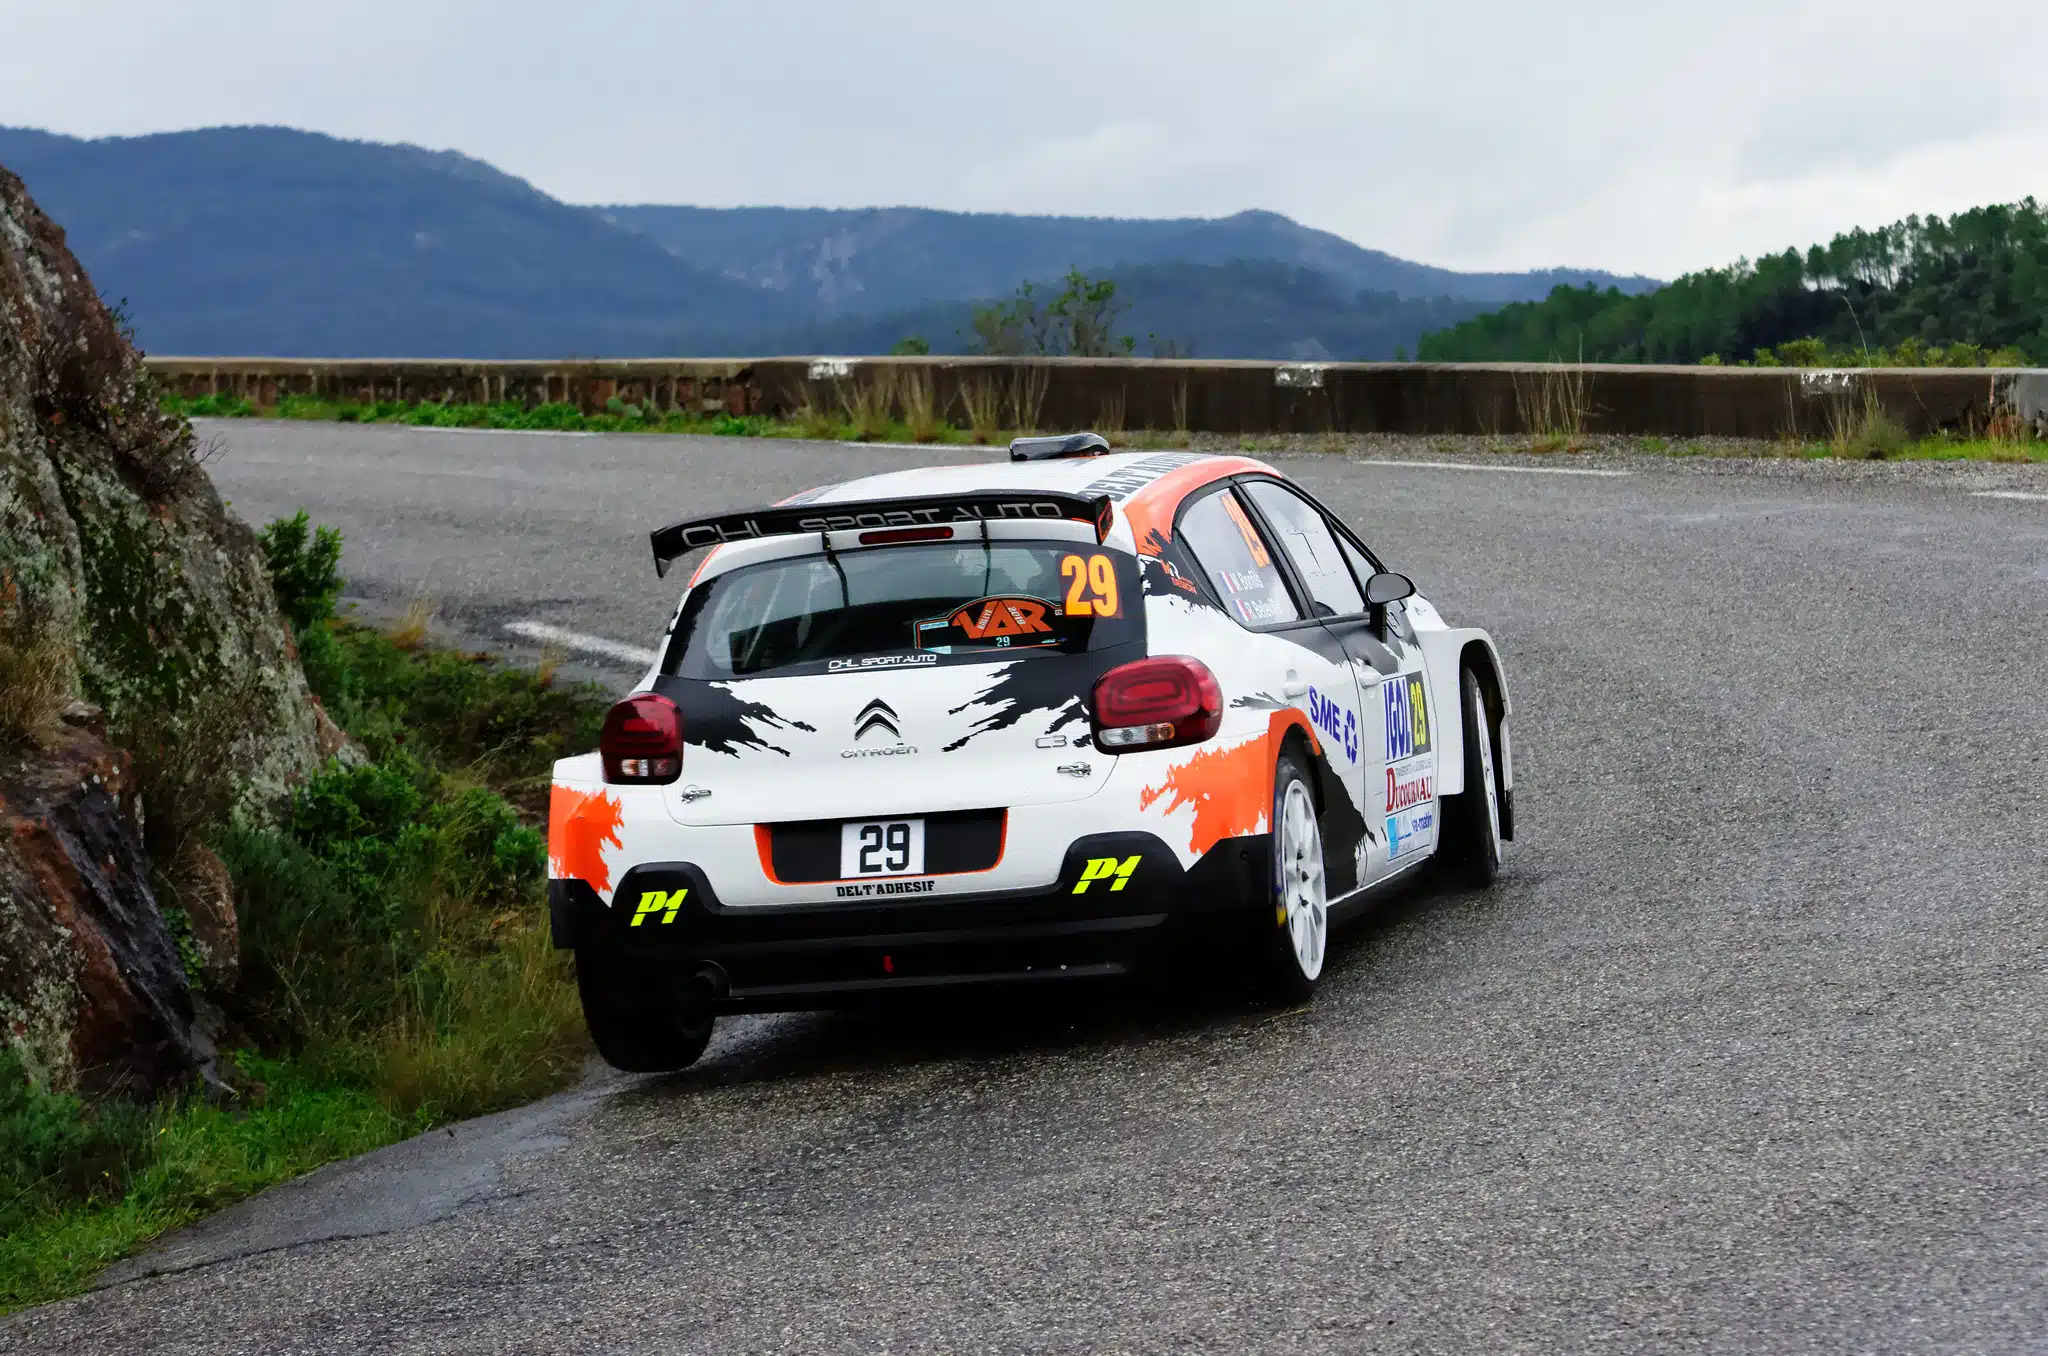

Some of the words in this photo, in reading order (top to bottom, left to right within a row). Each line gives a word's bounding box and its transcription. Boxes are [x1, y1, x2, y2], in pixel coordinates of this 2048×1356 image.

[682, 519, 765, 547] CHL
[799, 508, 940, 533] SPORT
[952, 502, 1063, 522] AUTO
[1061, 554, 1118, 617] 29
[952, 599, 1054, 640] VAR
[977, 609, 993, 630] RALLYE
[1008, 606, 1026, 626] 2019
[996, 636, 1011, 648] 29
[828, 659, 859, 670] CHL
[861, 656, 903, 666] SPORT
[903, 654, 937, 663] AUTO
[1309, 685, 1341, 743] SME
[1383, 679, 1411, 760] IGOL
[1410, 681, 1426, 746] 29
[840, 742, 918, 759] CITROËN
[1035, 734, 1067, 749] C3
[860, 823, 910, 873] 29
[836, 880, 935, 898] DELT'ADHESIF
[1072, 855, 1142, 894] P1
[630, 889, 688, 927] P1
